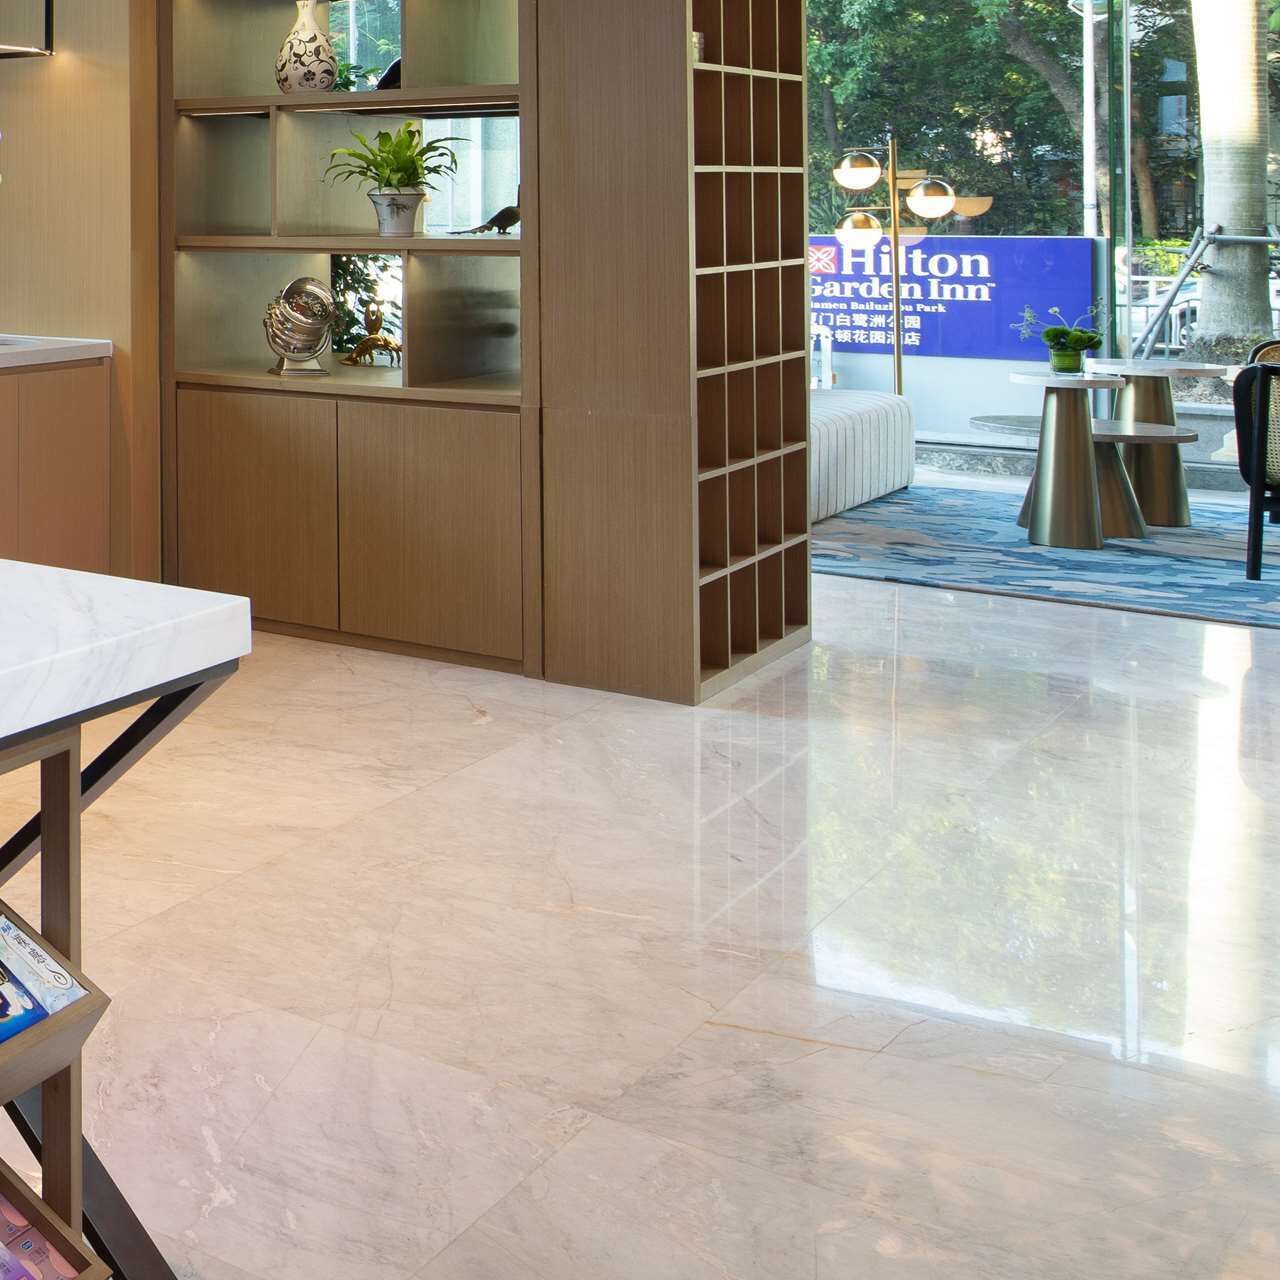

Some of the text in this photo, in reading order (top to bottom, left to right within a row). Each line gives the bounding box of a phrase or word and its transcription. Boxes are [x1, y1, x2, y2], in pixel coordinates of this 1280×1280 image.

[840, 245, 991, 278] Hilton
[811, 276, 923, 300] Garden
[917, 303, 947, 313] Park
